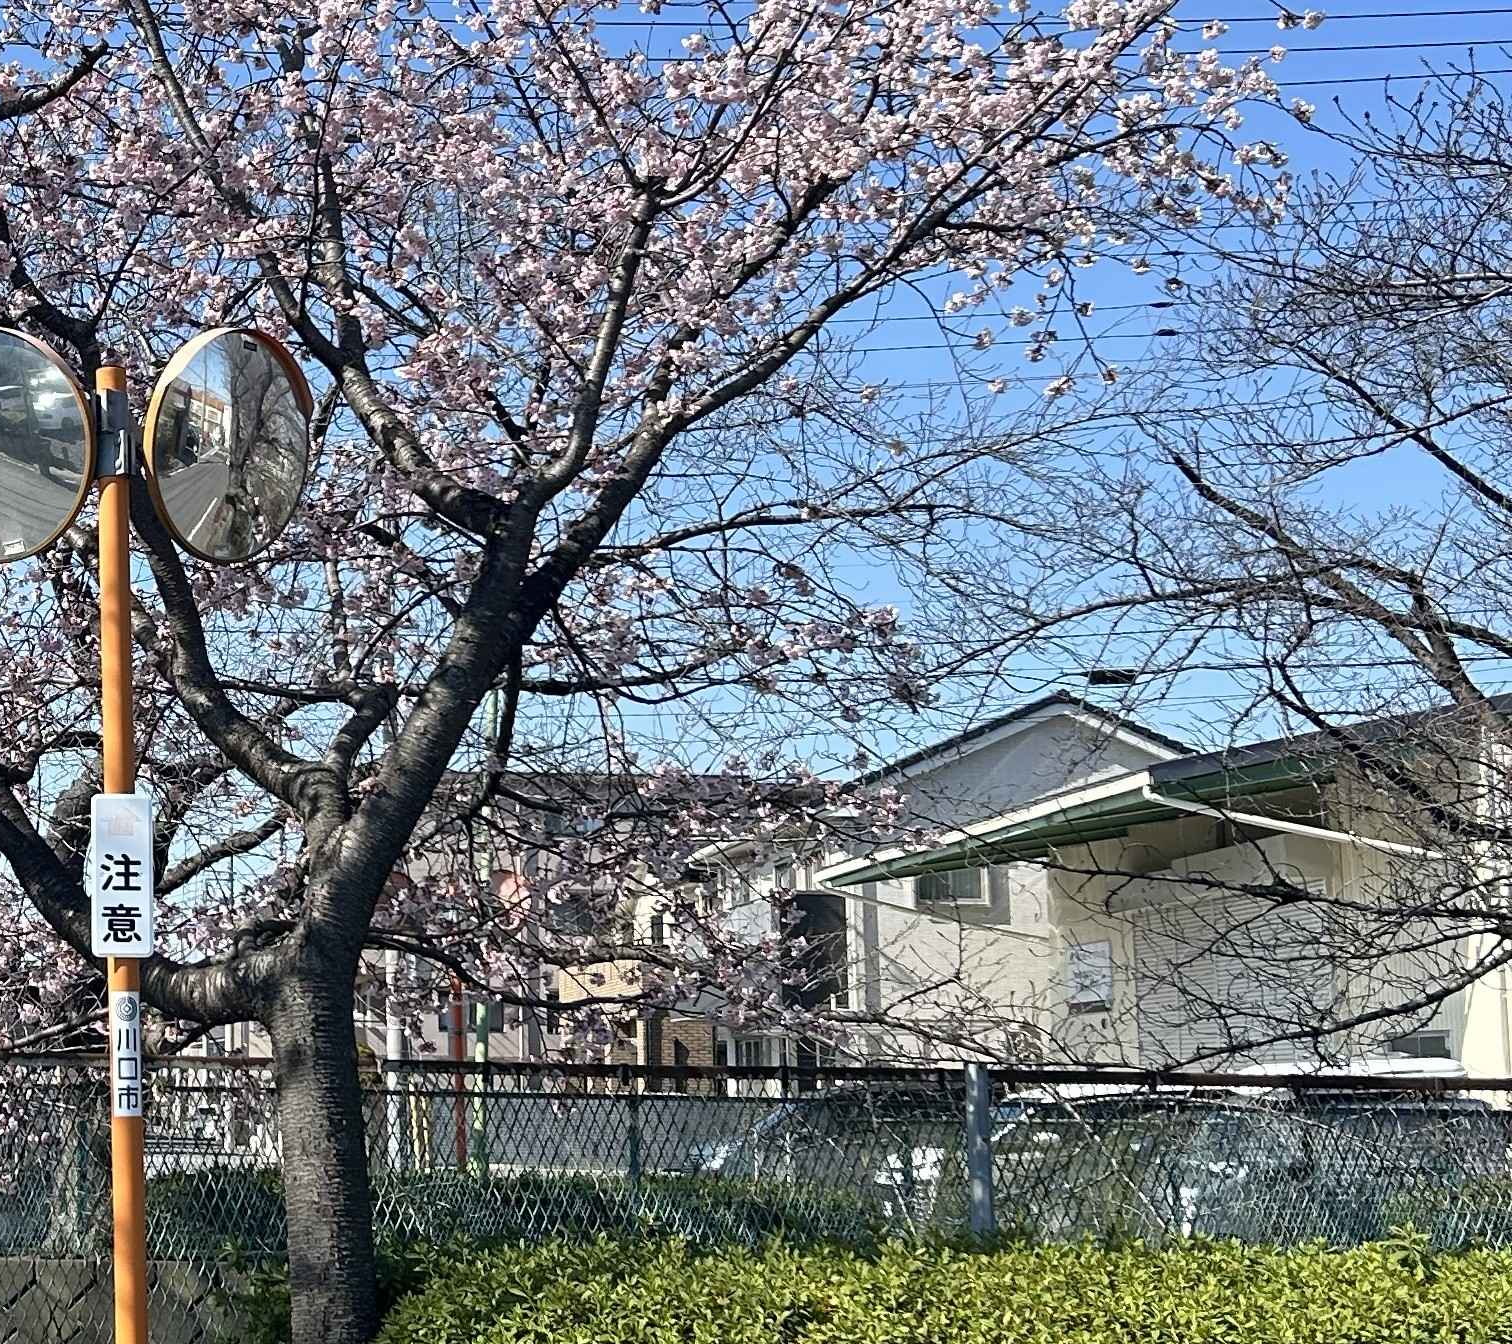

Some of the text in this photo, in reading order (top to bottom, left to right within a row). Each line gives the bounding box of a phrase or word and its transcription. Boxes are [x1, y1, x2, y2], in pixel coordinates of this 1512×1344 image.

[100, 853, 142, 943] 注意
[117, 1027, 139, 1110] 川口市
